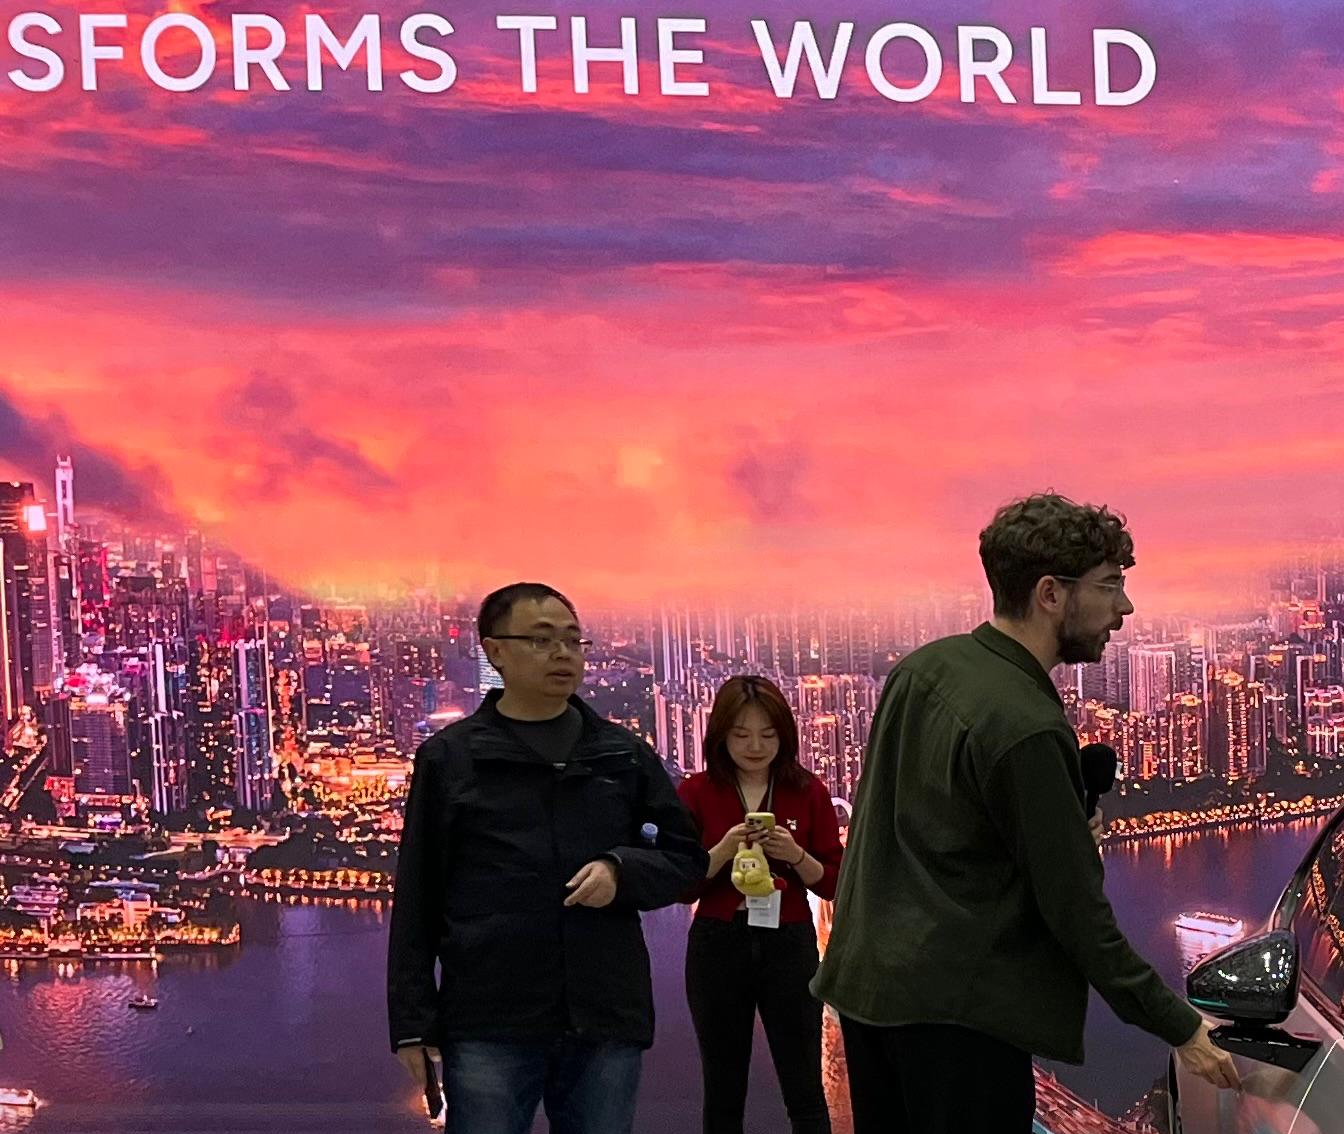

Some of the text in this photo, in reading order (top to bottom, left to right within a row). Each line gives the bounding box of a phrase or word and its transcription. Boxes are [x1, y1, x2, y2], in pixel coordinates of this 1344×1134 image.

[7, 13, 1155, 105] SFORMS THE WORLD
